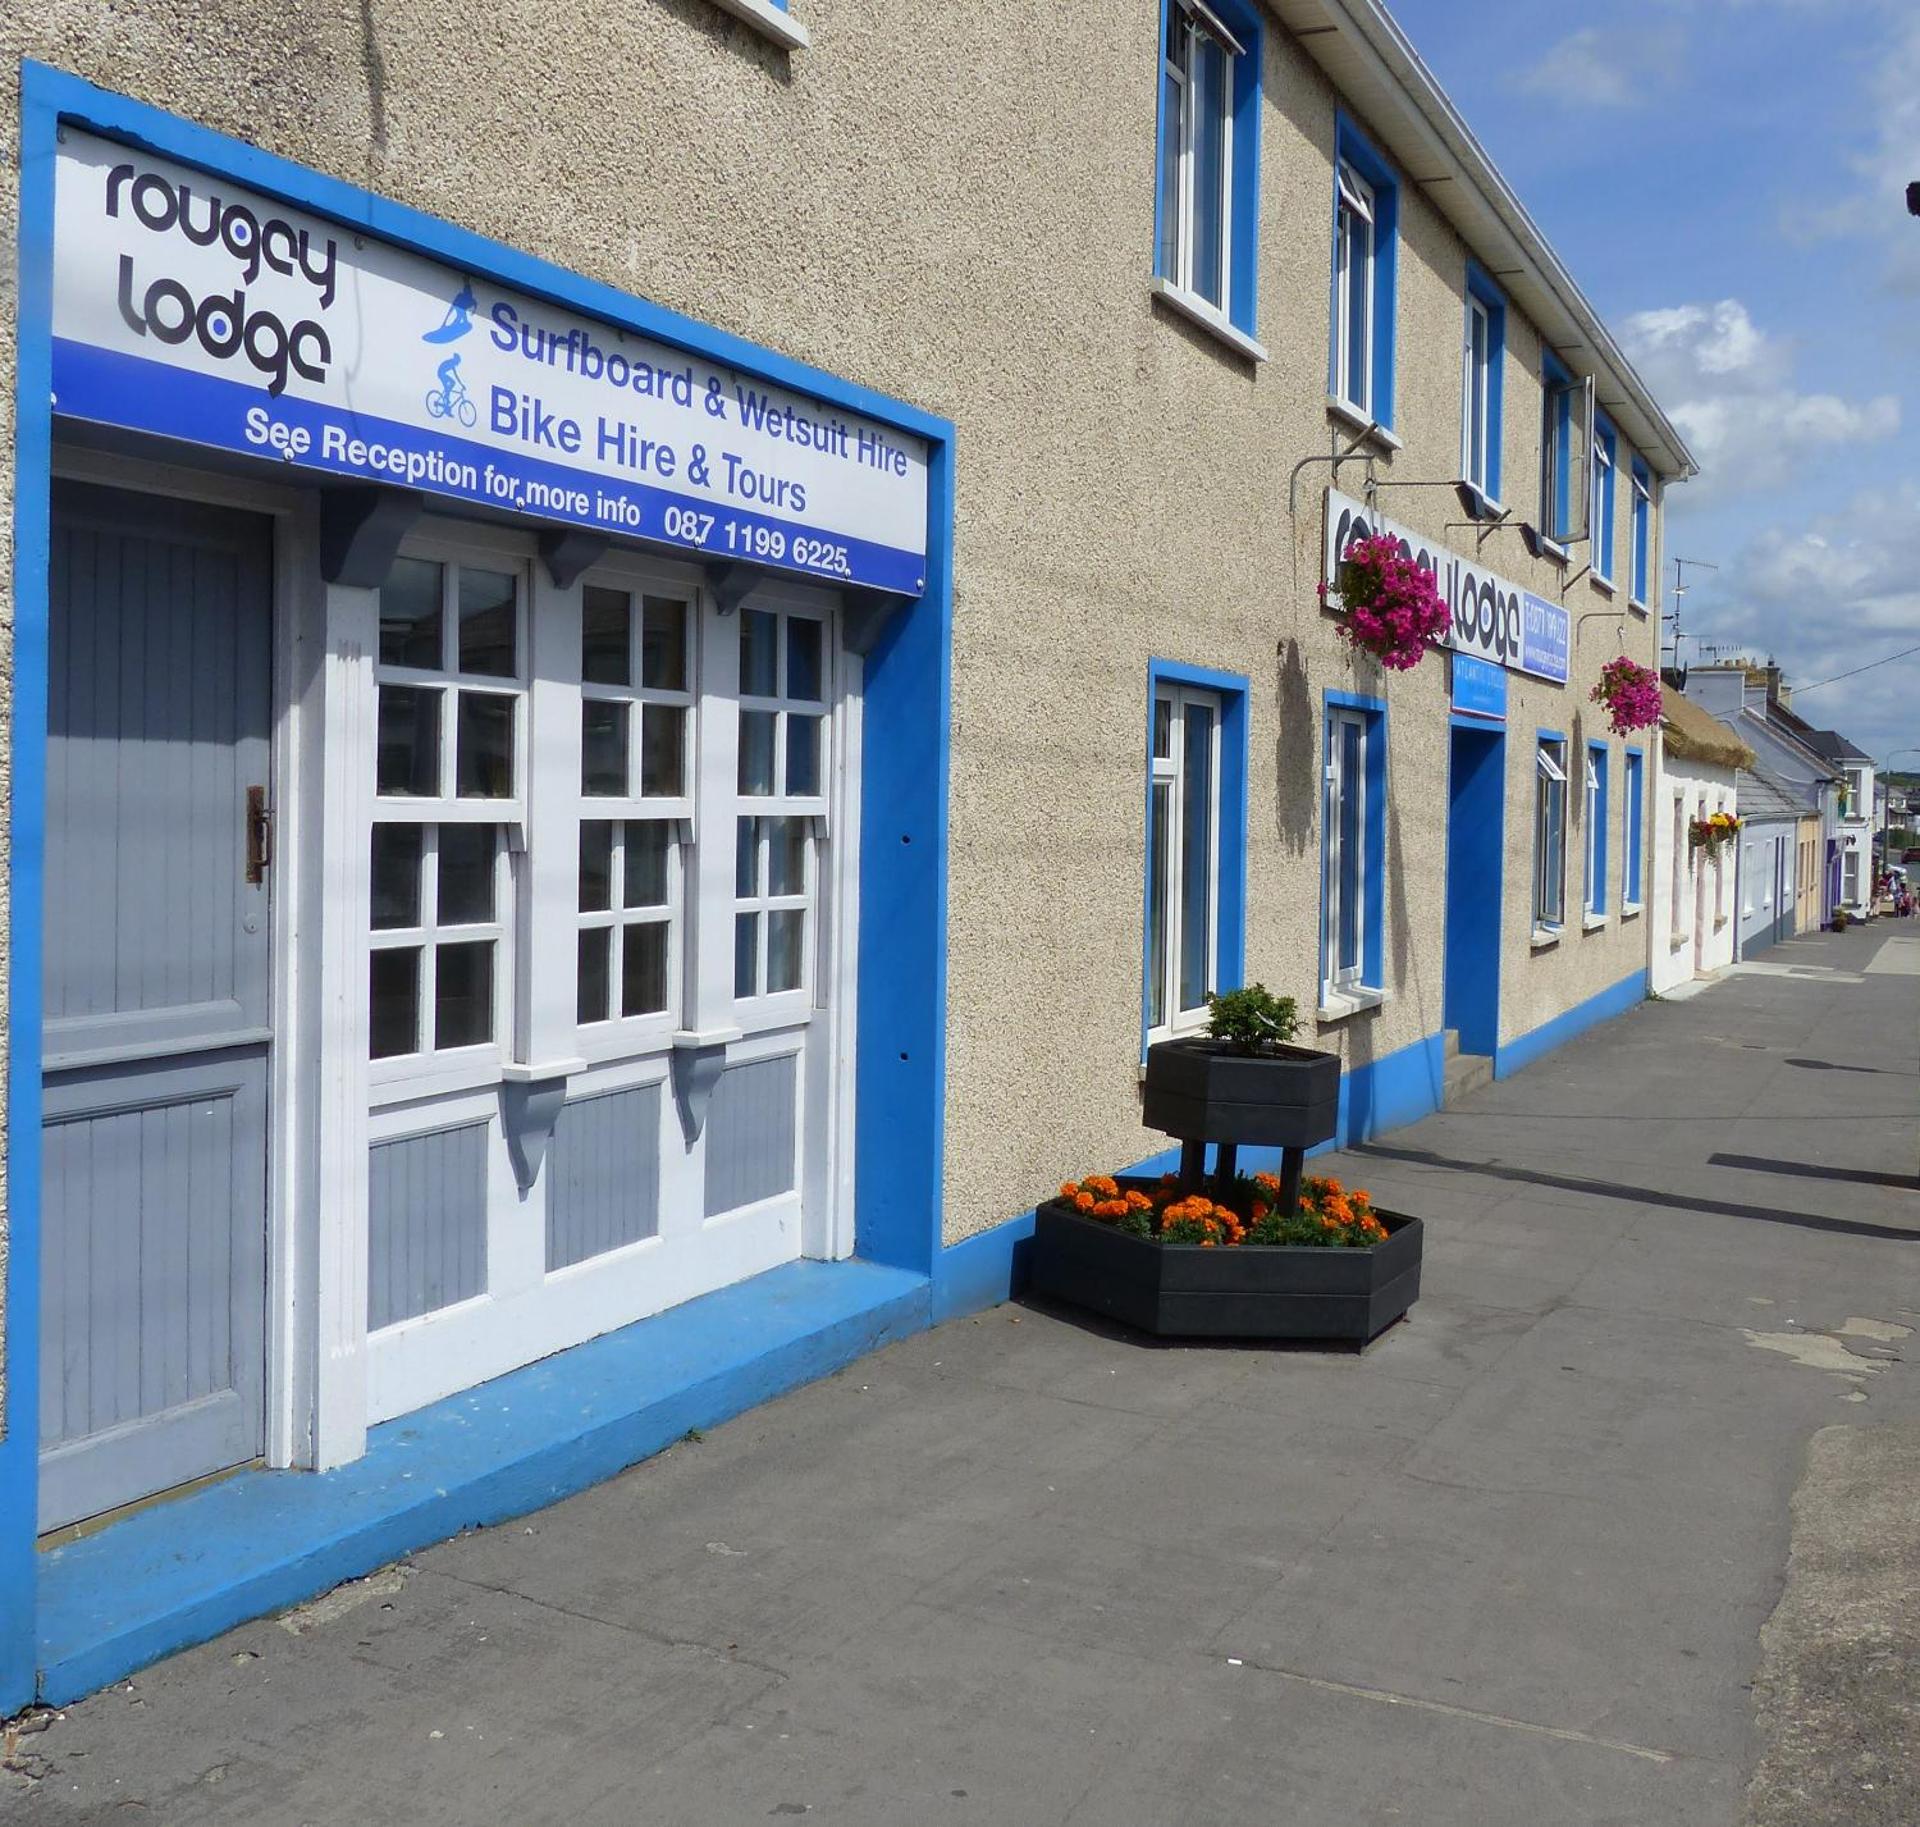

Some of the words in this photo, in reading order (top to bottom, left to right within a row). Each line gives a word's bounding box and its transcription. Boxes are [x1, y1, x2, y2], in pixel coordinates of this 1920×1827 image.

[106, 164, 337, 310] rougey
[117, 253, 332, 399] lodge
[489, 301, 693, 409] Surfboard
[704, 375, 728, 420] &
[736, 385, 849, 460] Wetsuit
[857, 426, 908, 478] Hire
[245, 407, 311, 454] See
[322, 424, 477, 491] Reception
[484, 464, 519, 501] for
[526, 480, 590, 517] more
[597, 490, 641, 527] info
[490, 384, 582, 454] Bike
[597, 416, 676, 478] Hire
[688, 443, 711, 489] &
[722, 451, 807, 513] Tours
[664, 506, 715, 544] 087
[724, 521, 786, 560] 1199
[792, 536, 849, 574] 6225
[1453, 559, 1520, 666] lodge
